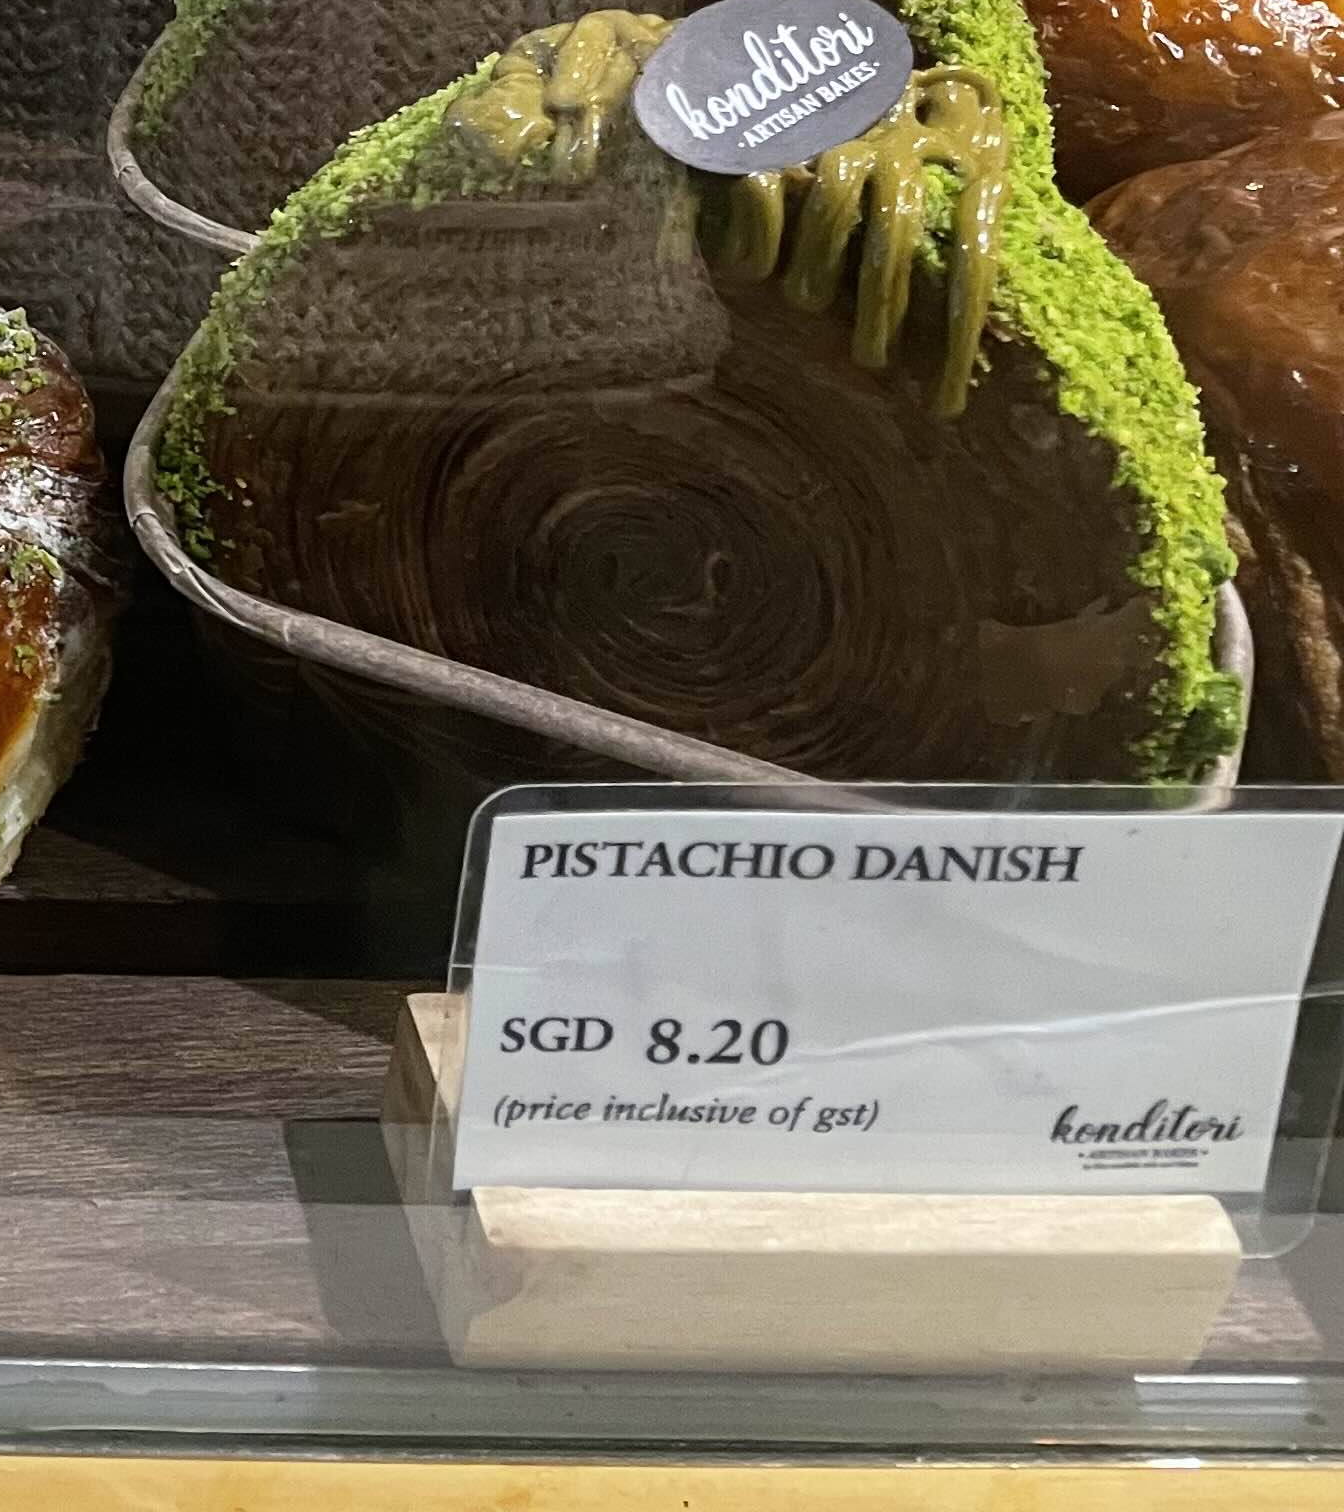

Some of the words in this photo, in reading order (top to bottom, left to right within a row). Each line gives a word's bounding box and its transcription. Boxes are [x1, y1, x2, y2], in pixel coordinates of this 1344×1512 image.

[666, 12, 873, 140] konditori
[742, 93, 823, 148] ARTISAN
[815, 61, 877, 104] BAKES
[520, 842, 835, 879] PISTACHIO
[853, 845, 1083, 883] DANISH
[500, 1017, 613, 1053] SGD
[645, 1019, 789, 1066] 8.20
[493, 1094, 592, 1127] (price
[603, 1094, 758, 1126] inclusive
[768, 1097, 813, 1129] of
[816, 1100, 879, 1132] gst)
[1051, 1099, 1244, 1143] konditori
